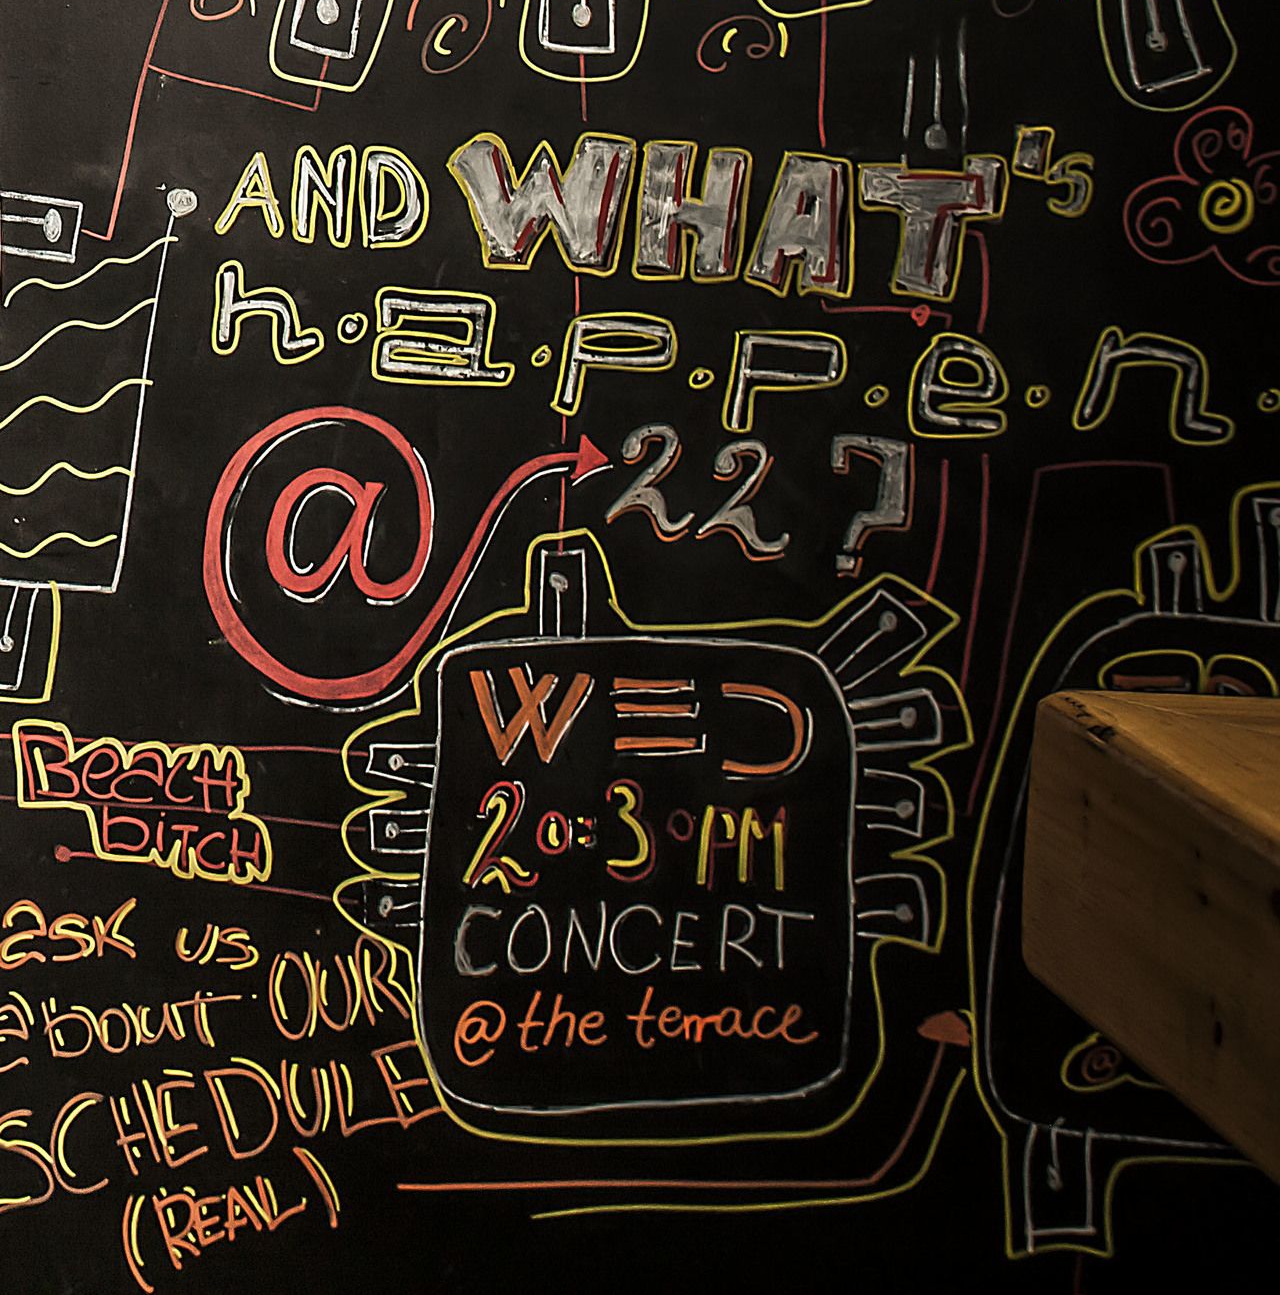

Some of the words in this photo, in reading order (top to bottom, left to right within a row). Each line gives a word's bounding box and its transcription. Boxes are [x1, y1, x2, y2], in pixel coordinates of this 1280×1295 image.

[214, 143, 429, 250] AND
[469, 663, 815, 782] WED
[268, 934, 417, 1041] OUR
[453, 901, 816, 976] CONCERT
[626, 987, 820, 1050] terrace
